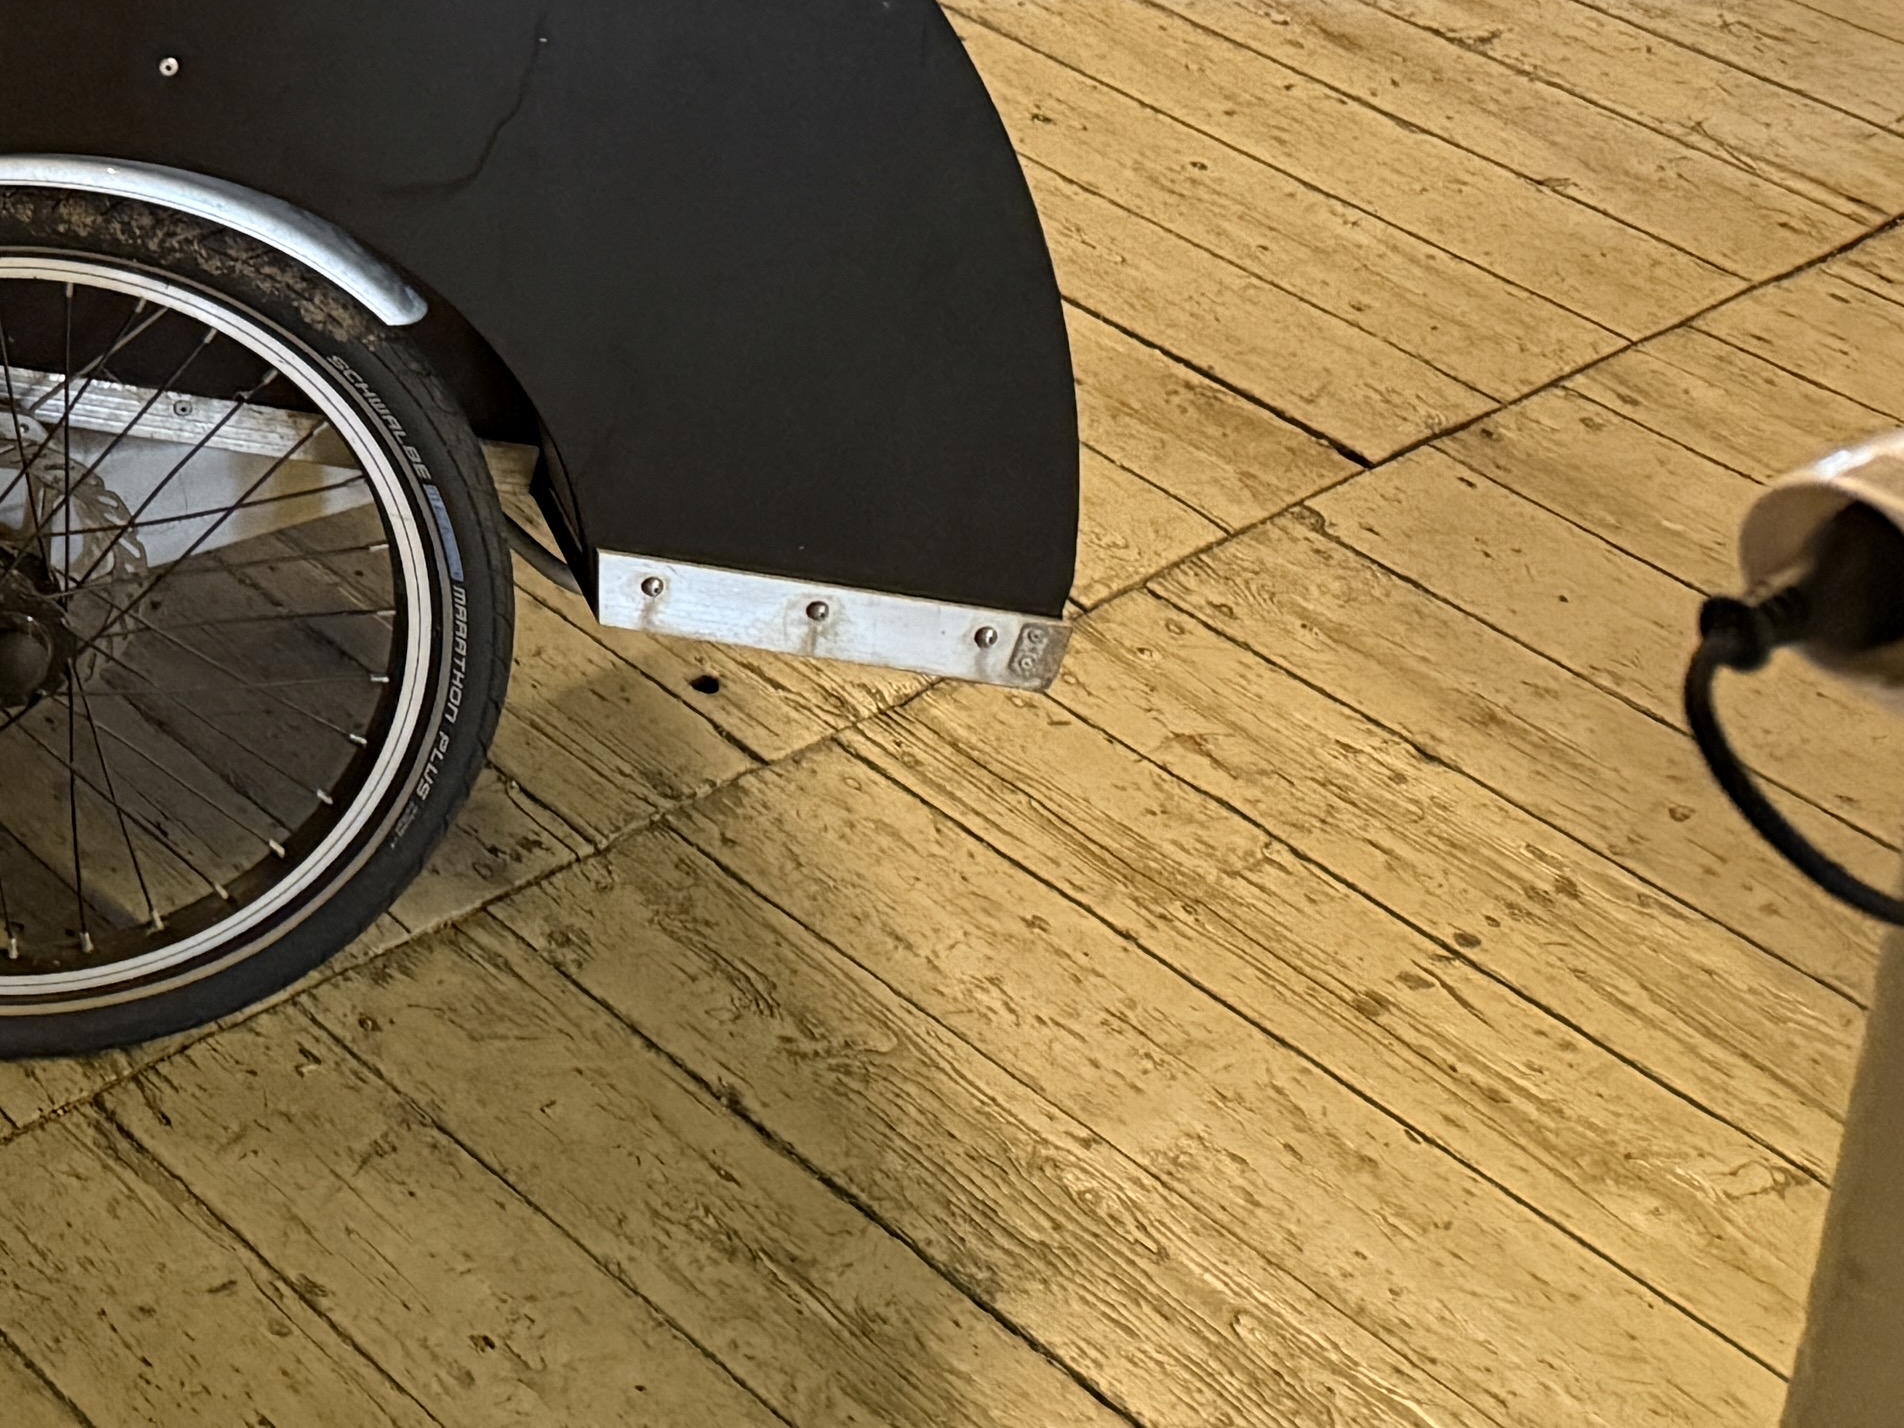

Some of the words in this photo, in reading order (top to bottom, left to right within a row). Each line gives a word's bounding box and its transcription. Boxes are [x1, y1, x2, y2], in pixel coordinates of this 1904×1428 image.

[327, 355, 432, 481] SCHWALBE
[444, 585, 468, 725] MARATHON
[416, 731, 450, 801] PLUS
